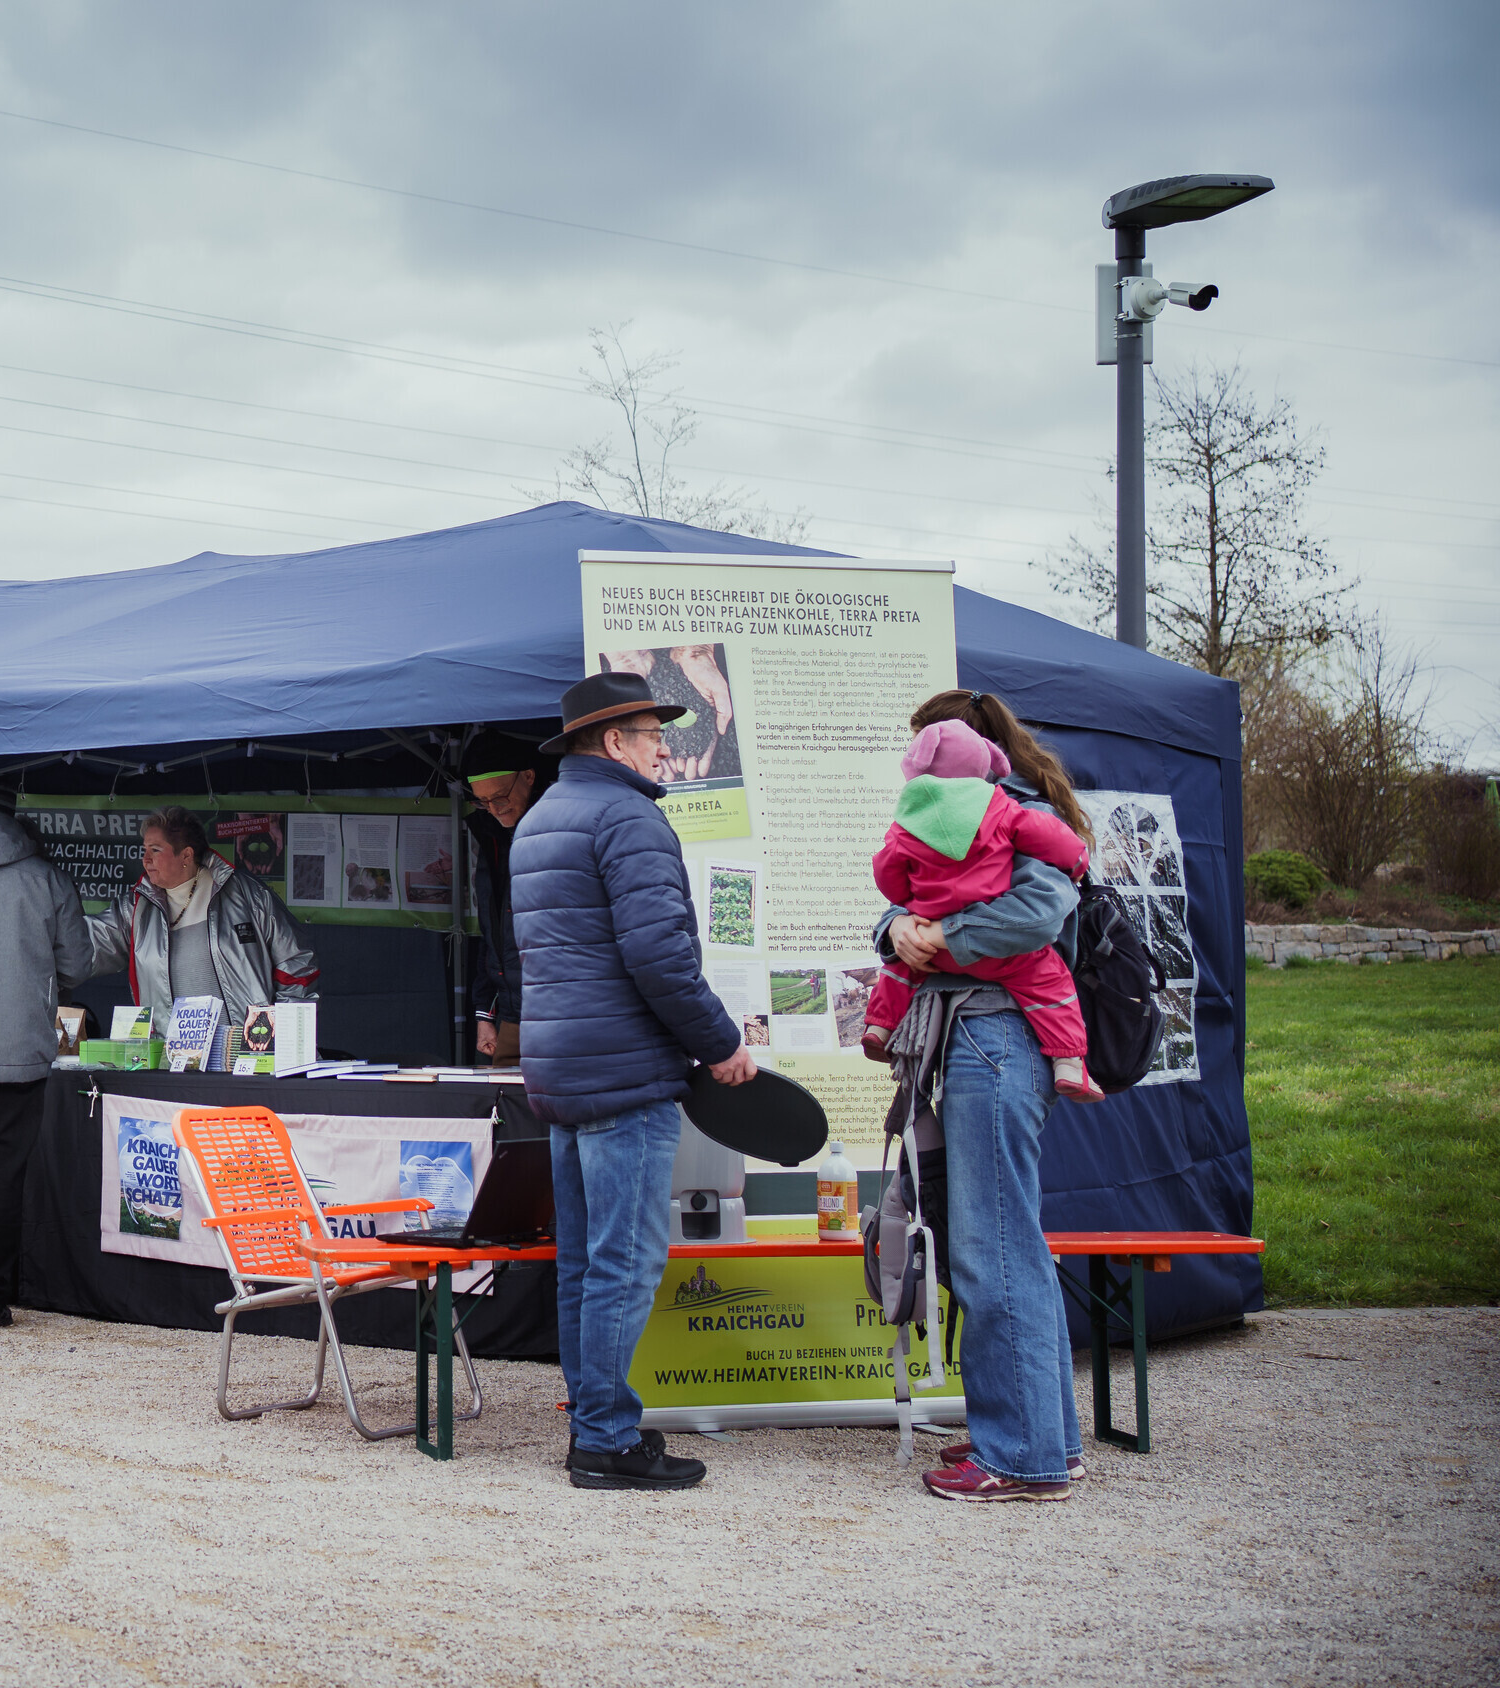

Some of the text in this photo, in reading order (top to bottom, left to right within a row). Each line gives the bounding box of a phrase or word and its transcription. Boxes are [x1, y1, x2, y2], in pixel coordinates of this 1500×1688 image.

[602, 586, 889, 606] NEUES BUCH BESCHREIBT DIE ÖKOLOGISCHE
[603, 602, 920, 623] DIMENSION VON PFLANZENKOHLE, TERRA PRETA
[604, 618, 873, 638] UND EM ALS BEITRAG ZUM KLIMASCHUTZ
[819, 649, 847, 657] Biokohle
[889, 650, 898, 658] ein
[878, 661, 916, 670] pyrolytische
[753, 668, 778, 678] kohlung
[787, 679, 826, 689] Anwendung
[768, 723, 809, 733] langjährigen
[812, 724, 853, 733] Erfahrungen
[869, 724, 891, 732] Vereins
[757, 733, 781, 741] wurden
[757, 743, 907, 754] Heimatverein Kraichgau herausgegeben wurd
[766, 772, 795, 781] Ursprung
[661, 800, 722, 814] RRA PRETA
[15, 812, 148, 836] RRA PRE
[45, 843, 145, 860] ACHHALTIGE
[58, 862, 124, 878] TZUNG
[791, 923, 805, 931] Buch
[800, 944, 816, 953] preta
[176, 1008, 210, 1019] KRAICH
[178, 1019, 208, 1030] GAUER
[179, 1029, 205, 1039] WORT
[168, 1040, 204, 1050] SCHATZ
[778, 1060, 796, 1068] Fazit
[829, 1074, 845, 1082] Terra
[847, 1074, 864, 1082] Preta
[866, 1074, 878, 1082] und
[806, 1085, 843, 1094] Werkzeuge
[872, 1084, 894, 1092] Böden
[816, 1094, 861, 1102] afreundlicher
[874, 1094, 895, 1104] gestal
[823, 1104, 878, 1114] hlenstoffbindung,
[841, 1115, 878, 1125] nachhaltige
[127, 1138, 180, 1160] KRAICH
[133, 1156, 178, 1176] GAUER
[136, 1172, 180, 1191] WORT
[126, 1187, 182, 1208] SCHATZ
[727, 1304, 805, 1314] HEIMATVEREIN
[688, 1314, 805, 1332] KRAICHGAU
[746, 1347, 882, 1361] BUCH ZU BEZIEHEN UNTER
